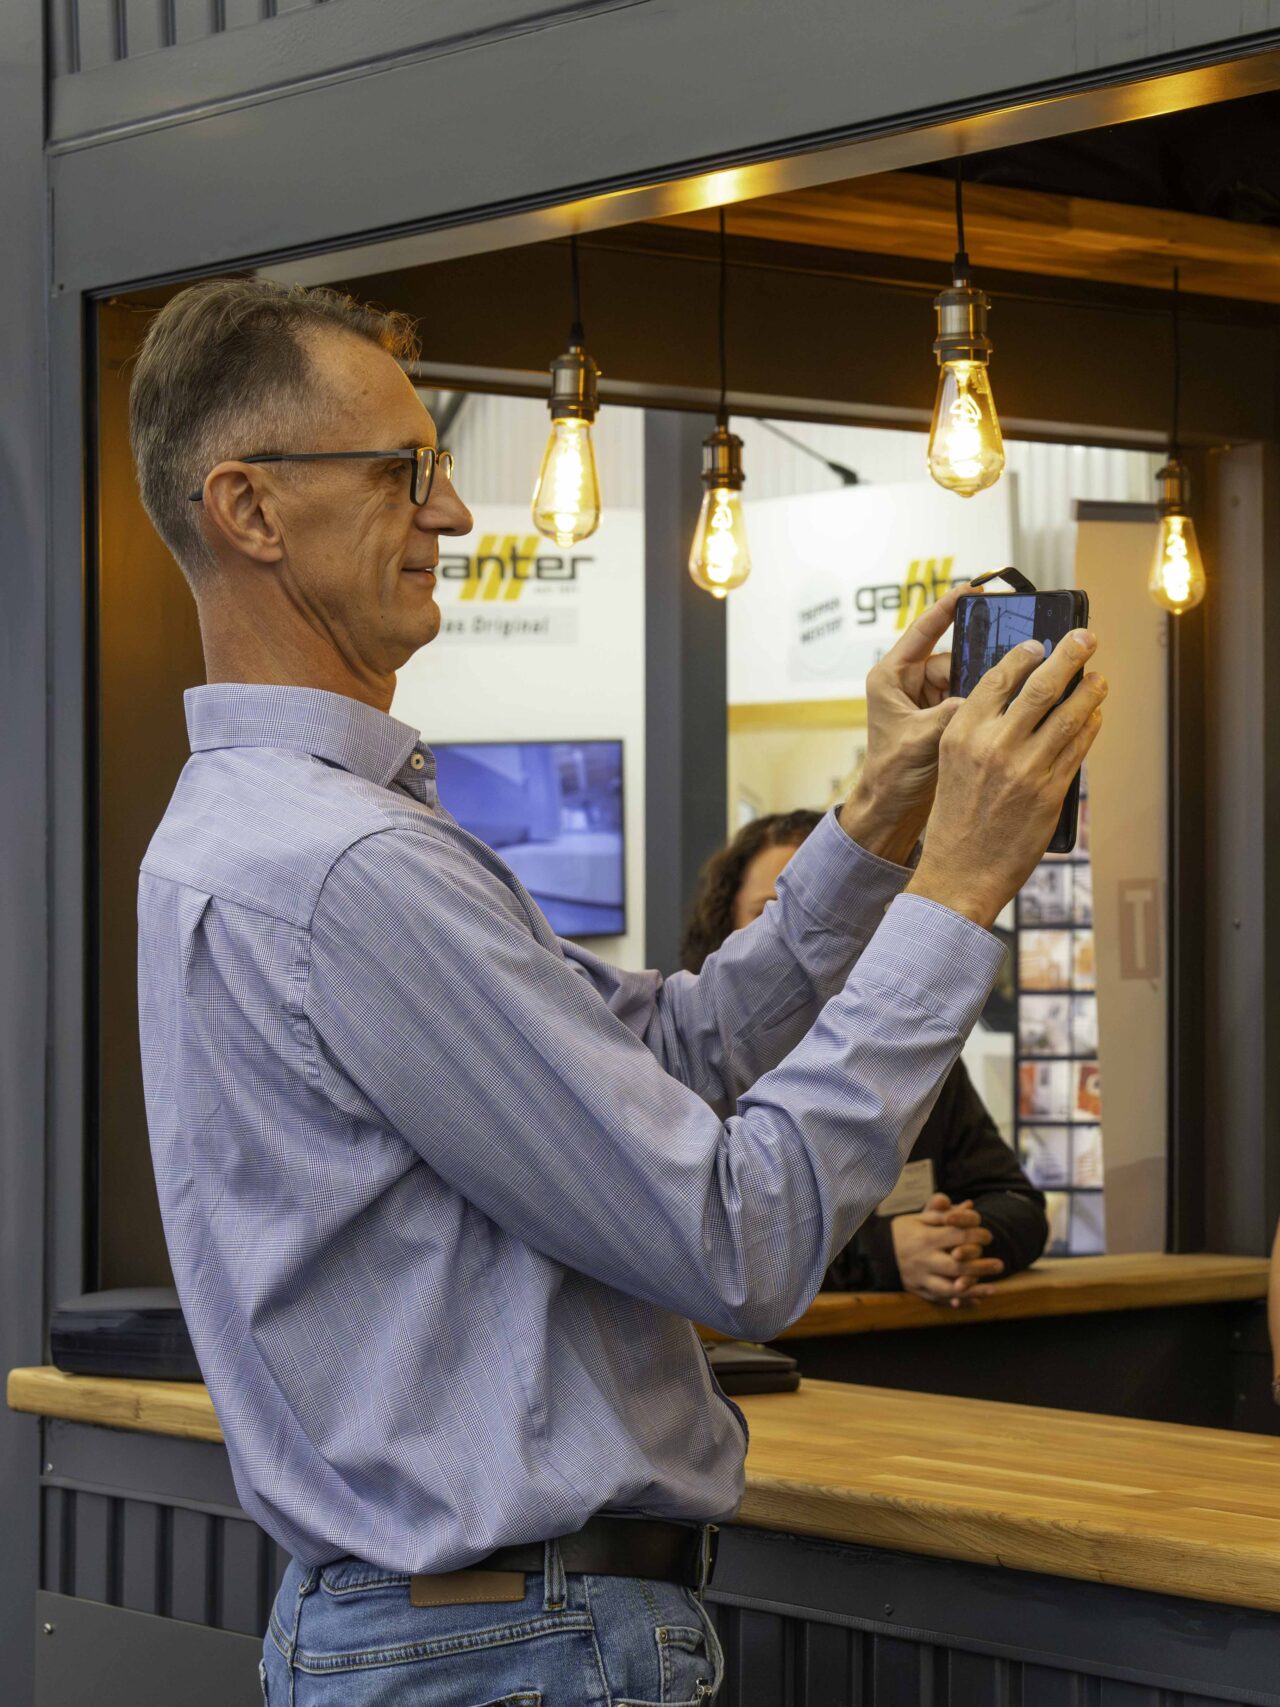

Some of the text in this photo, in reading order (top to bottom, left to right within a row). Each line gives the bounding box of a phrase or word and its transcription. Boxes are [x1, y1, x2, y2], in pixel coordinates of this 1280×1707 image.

[438, 545, 595, 581] anter
[855, 568, 972, 625] gant
[473, 615, 549, 640] Original
